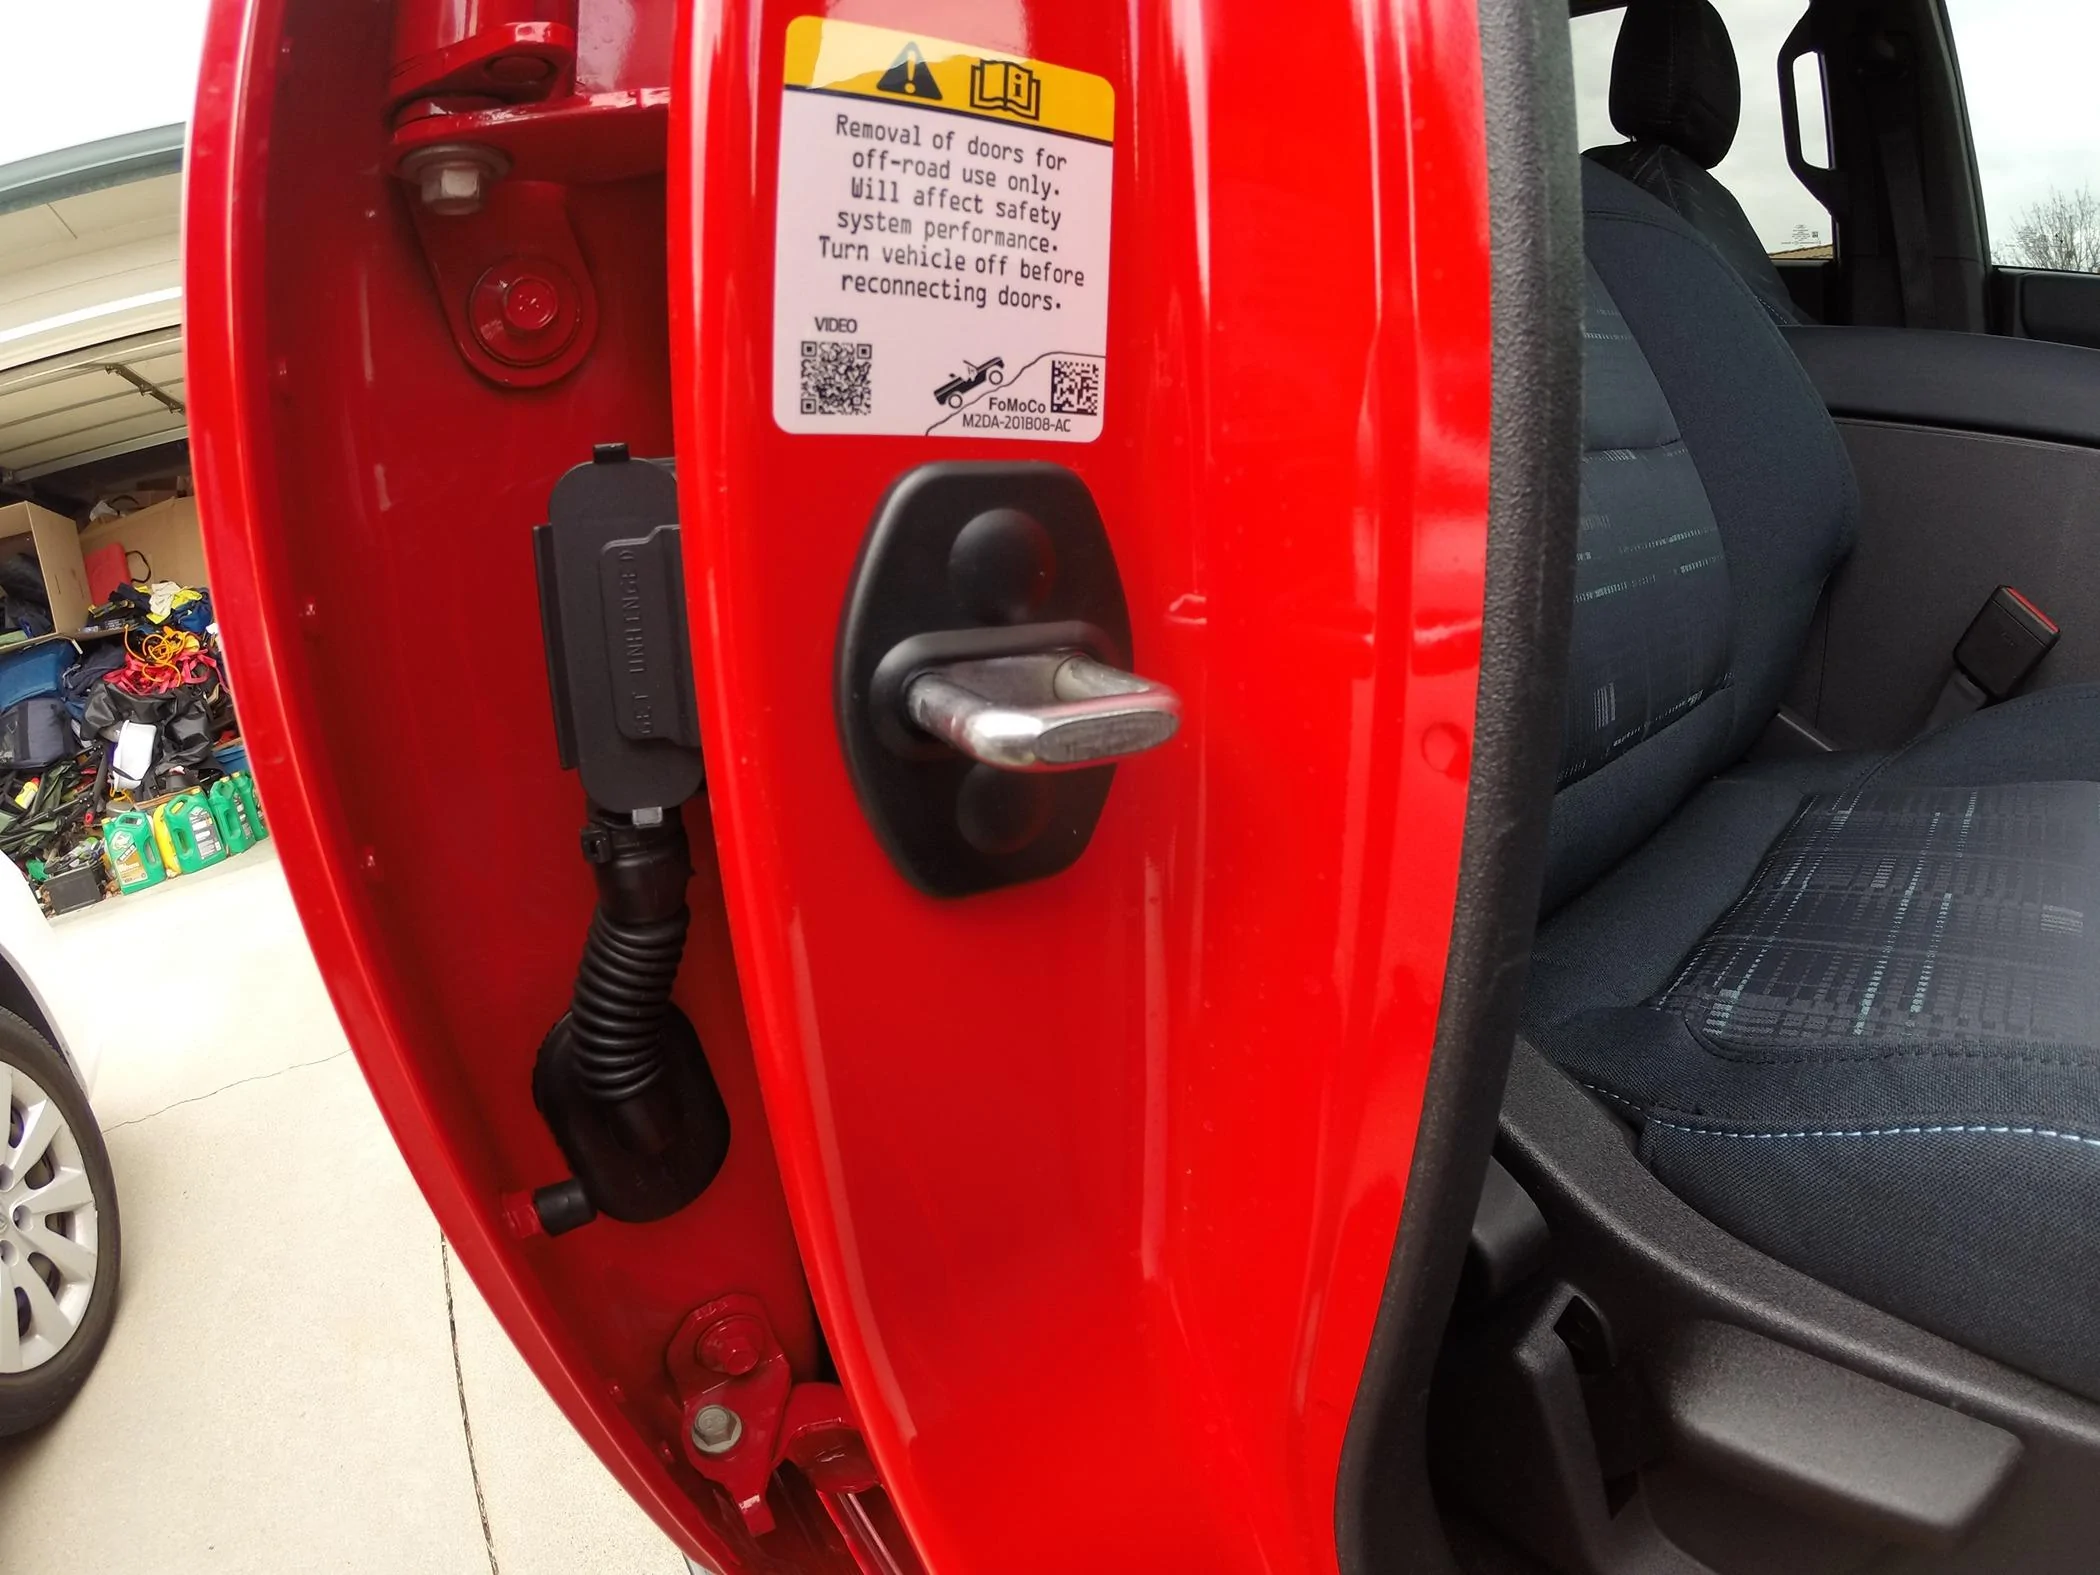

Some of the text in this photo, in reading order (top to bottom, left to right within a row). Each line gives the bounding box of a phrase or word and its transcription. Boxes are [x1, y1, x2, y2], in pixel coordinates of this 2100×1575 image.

[837, 114, 1067, 170] Removal of doors for
[853, 150, 1059, 201] off-road use only.
[852, 176, 1061, 230] Will affect safety
[837, 209, 1058, 252] system performance.
[819, 235, 1084, 287] Turn vehicle off before
[842, 272, 1060, 311] reconnecting doors.
[814, 316, 857, 333] VIDEO
[962, 413, 1071, 433] M2DA-201B08-AC
[989, 397, 1046, 414] FoMoCo
